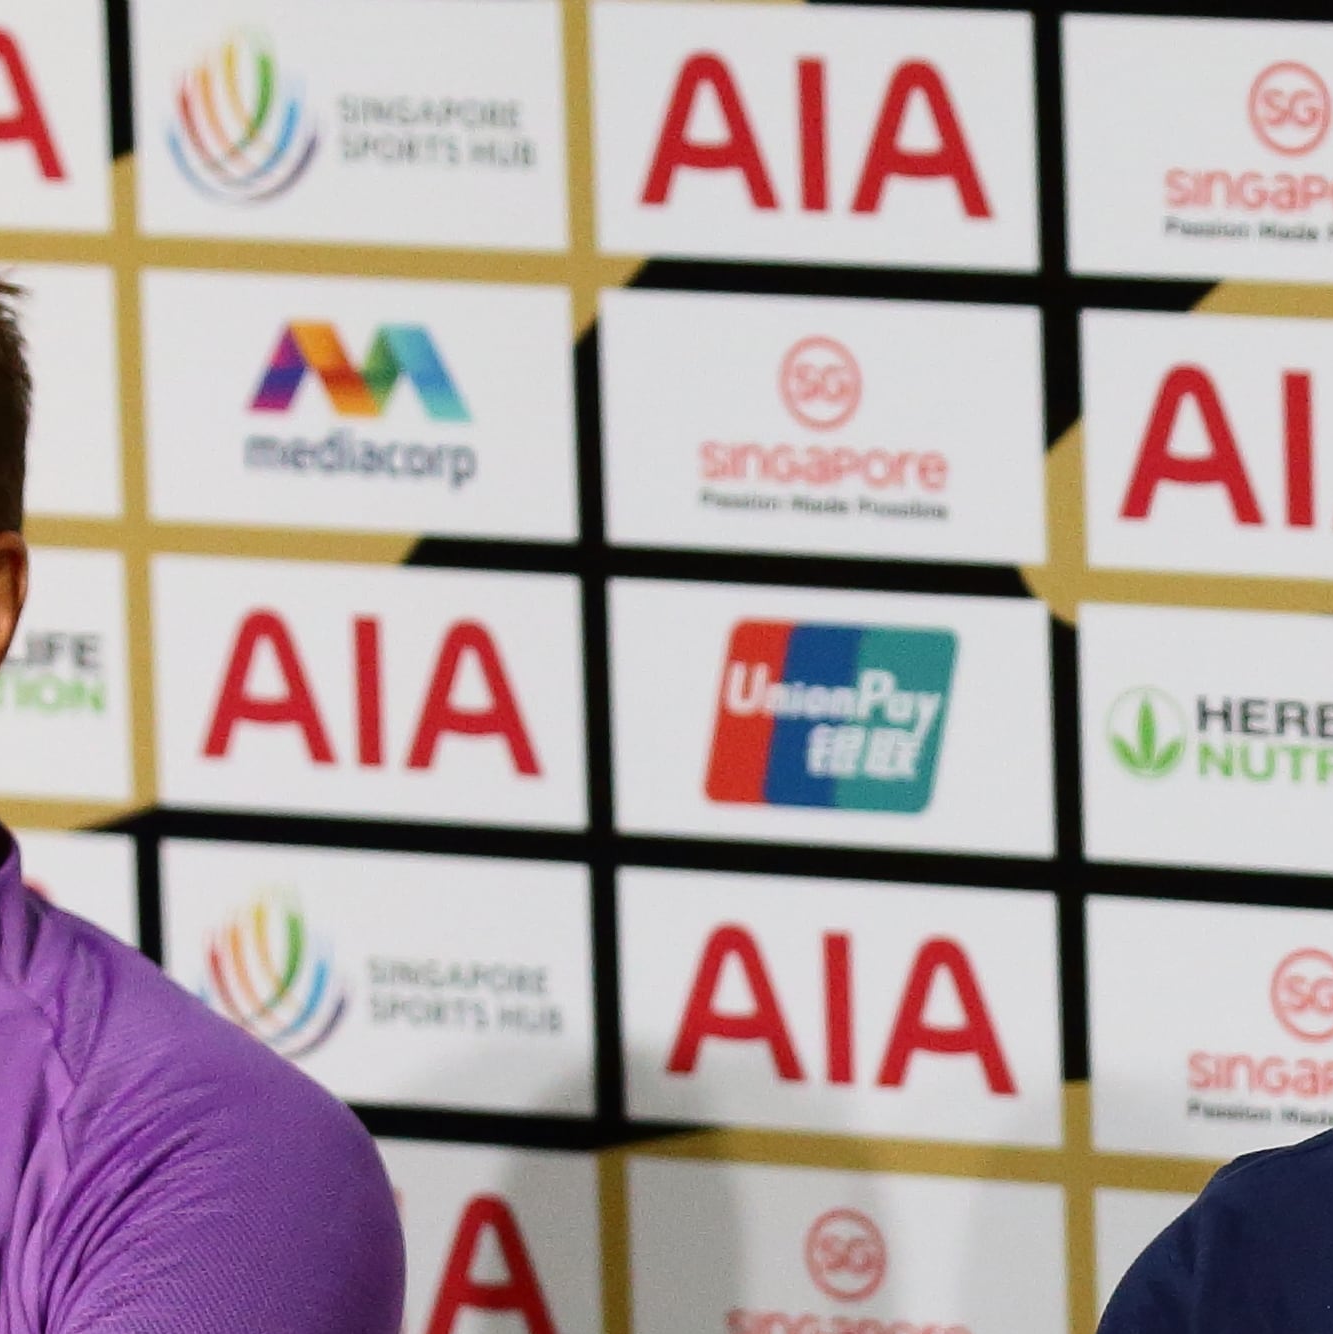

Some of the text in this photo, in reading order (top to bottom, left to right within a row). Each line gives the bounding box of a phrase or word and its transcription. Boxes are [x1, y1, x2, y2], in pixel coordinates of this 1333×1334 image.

[339, 96, 522, 129] SINGAPORE
[1259, 88, 1326, 127] SG
[339, 134, 538, 169] SPORTS HUB
[638, 49, 996, 219] AIA
[1165, 216, 1251, 241] Passion
[1258, 222, 1319, 244] Made
[243, 428, 478, 486] mediacorp
[4, 630, 102, 669] LIFE
[200, 606, 543, 777] AIA
[721, 661, 942, 737] UnionPay
[367, 957, 547, 992] SINGAPORE
[369, 993, 563, 1034] SPORTS HUB
[667, 923, 1018, 1096] AIA
